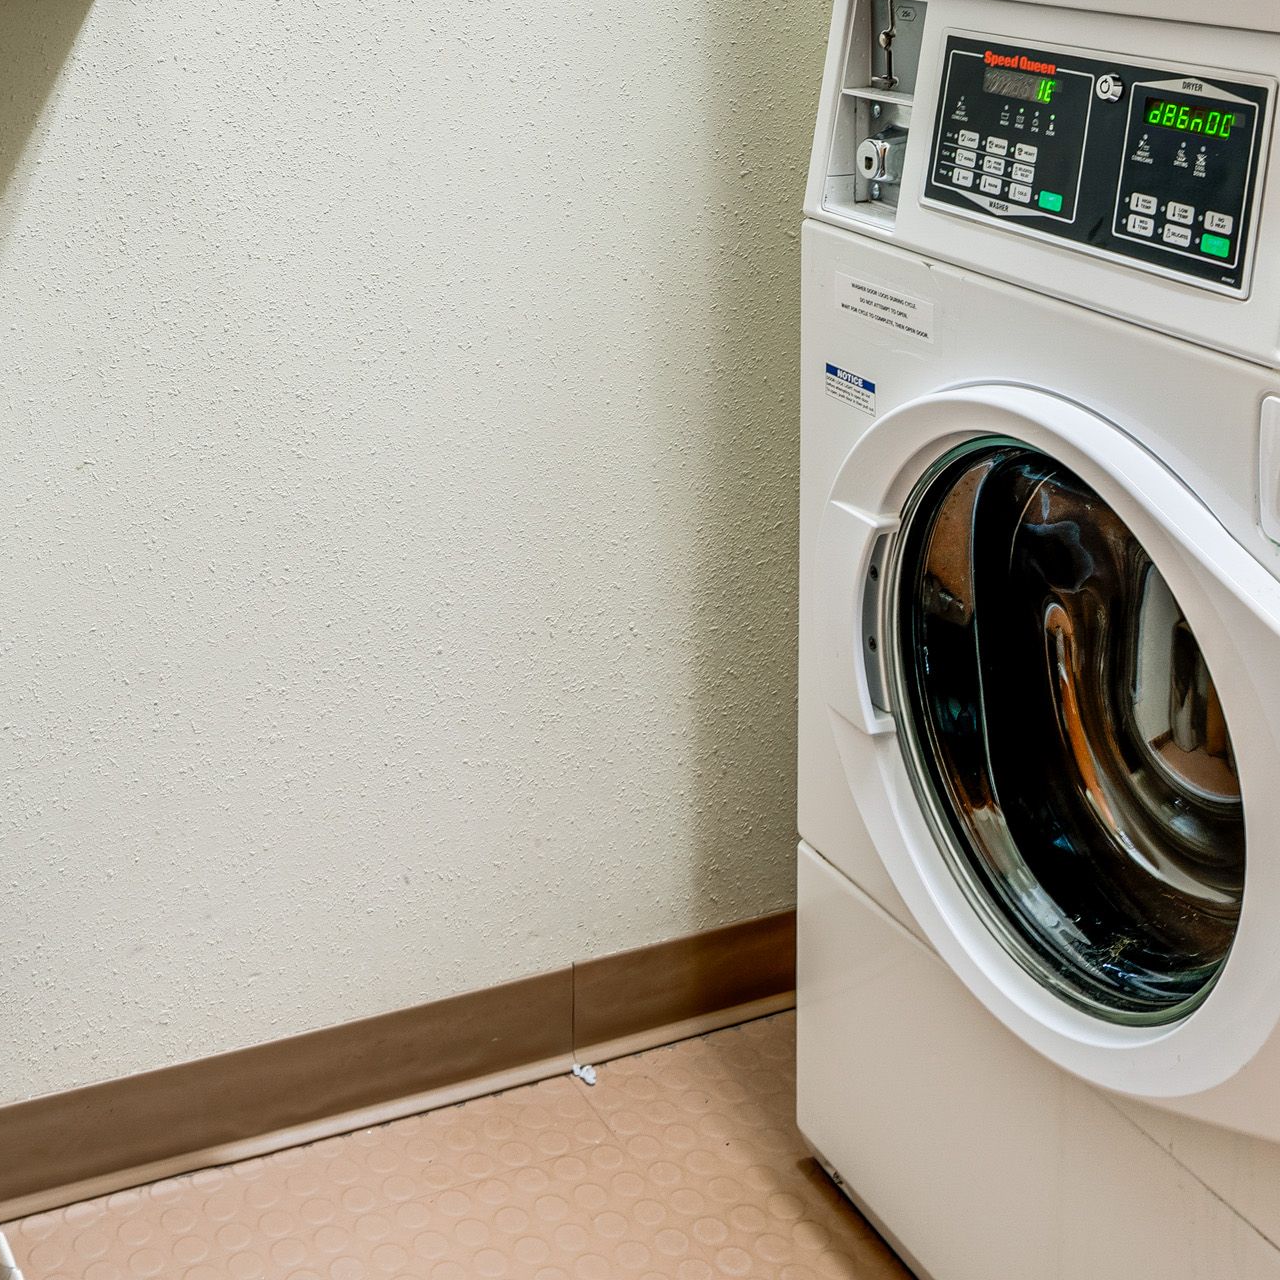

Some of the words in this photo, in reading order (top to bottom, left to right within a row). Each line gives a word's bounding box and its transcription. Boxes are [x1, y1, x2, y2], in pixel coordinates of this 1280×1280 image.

[984, 50, 1019, 69] Speed
[1020, 54, 1056, 75] Queen
[1181, 80, 1203, 92] DRYER
[988, 200, 1009, 212] WASHER
[837, 369, 864, 387] NOTICE
